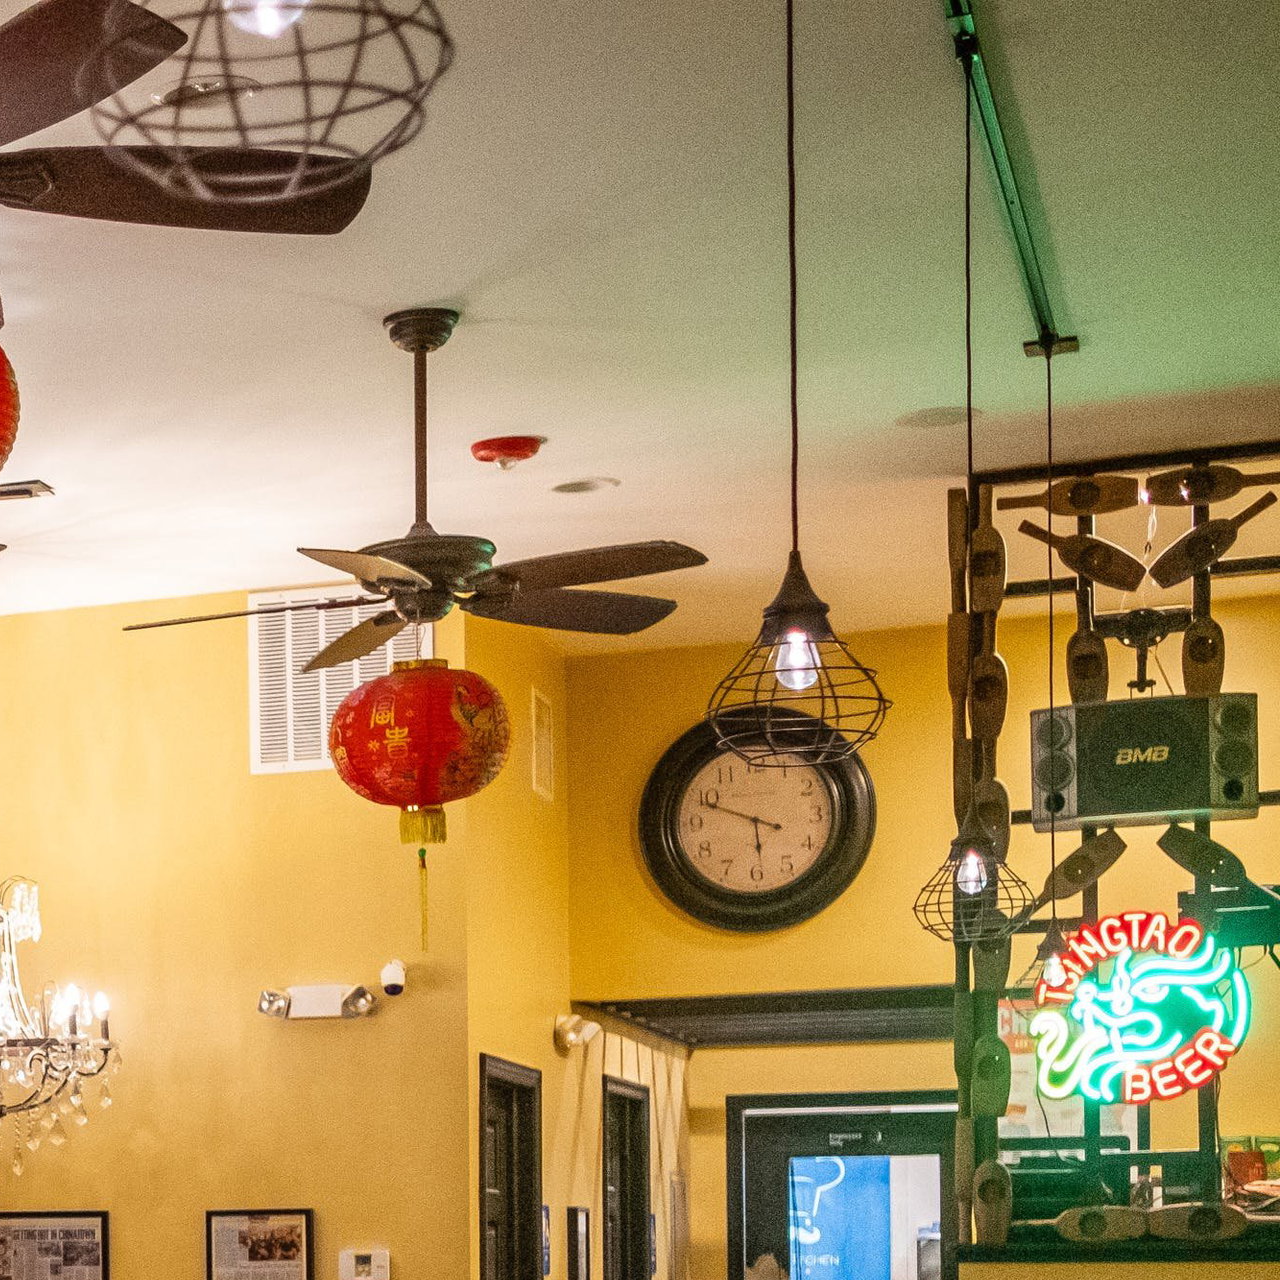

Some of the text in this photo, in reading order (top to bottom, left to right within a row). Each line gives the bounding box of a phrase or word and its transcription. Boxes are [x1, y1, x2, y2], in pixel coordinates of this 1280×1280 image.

[1115, 746, 1169, 766] BMB
[801, 778, 813, 797] 2
[690, 813, 703, 831] 9
[809, 804, 823, 824] 3
[698, 840, 712, 858] 8
[802, 834, 815, 850] 4
[720, 858, 733, 876] 7
[750, 863, 763, 881] 6
[780, 855, 794, 874] 5
[1123, 1031, 1236, 1101] BEER
